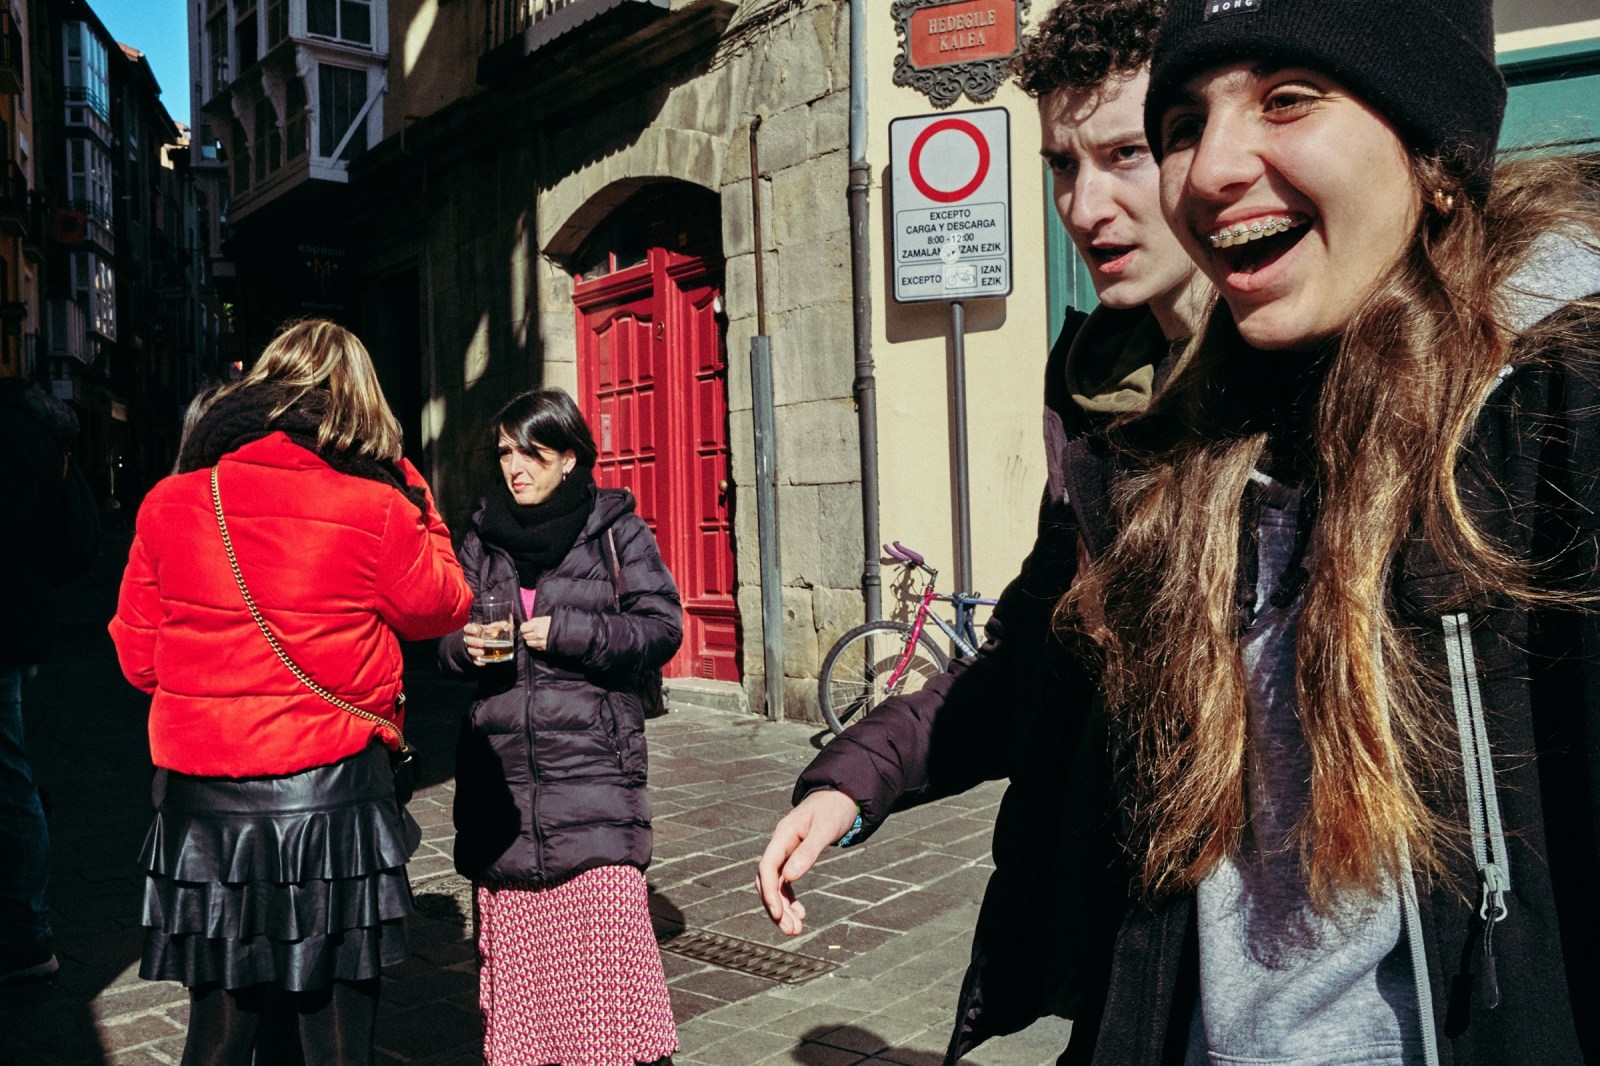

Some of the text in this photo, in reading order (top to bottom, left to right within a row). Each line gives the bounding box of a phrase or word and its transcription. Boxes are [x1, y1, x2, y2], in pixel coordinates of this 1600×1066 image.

[939, 31, 985, 51] KALEA
[930, 209, 971, 221] EXCEPTO
[906, 219, 996, 235] CARGA Y DESCARGA
[927, 235, 944, 245] 8:00
[951, 233, 974, 243] 12:00
[298, 244, 345, 257] espacio
[981, 243, 1001, 252] EZIK
[981, 265, 1001, 274] IZAN
[901, 275, 942, 286] EXCEPTO
[981, 277, 1002, 286] EZIK
[656, 321, 665, 341] 2
